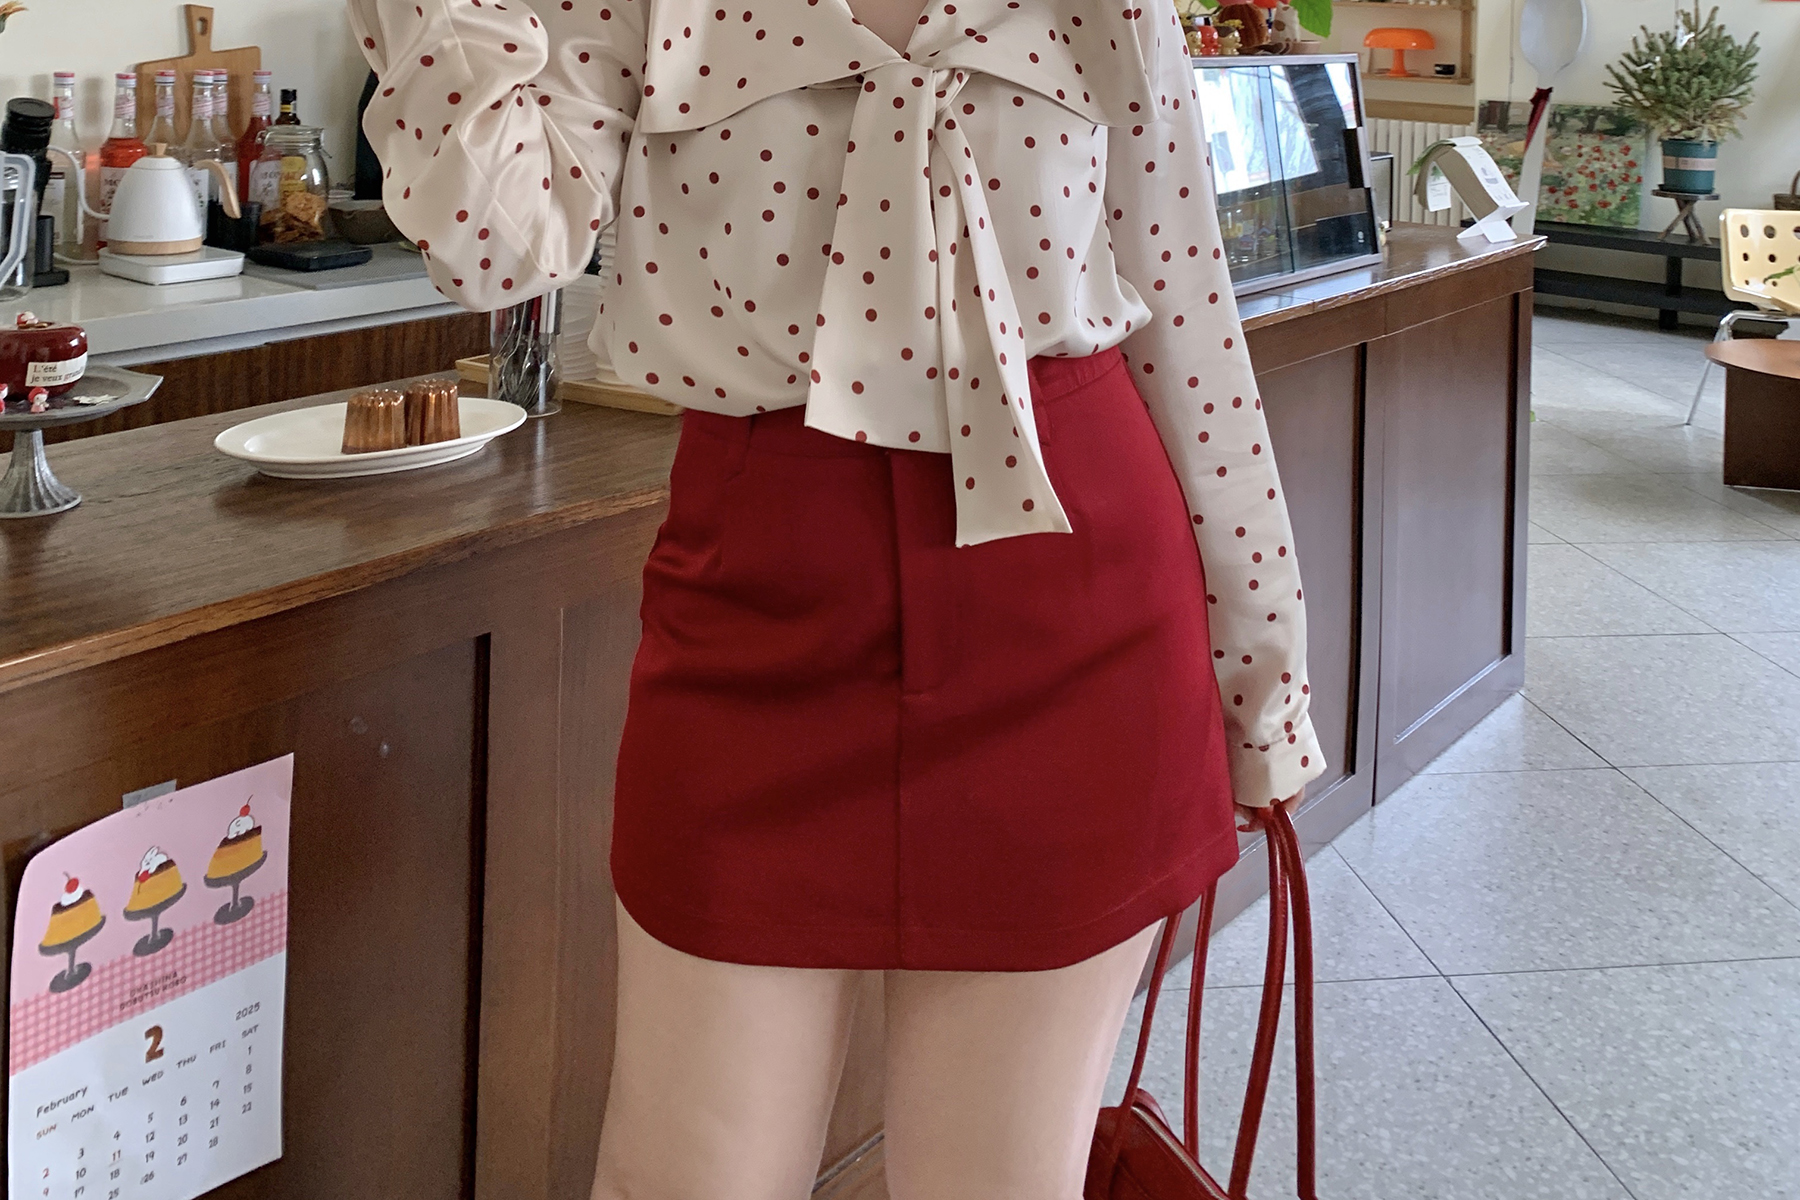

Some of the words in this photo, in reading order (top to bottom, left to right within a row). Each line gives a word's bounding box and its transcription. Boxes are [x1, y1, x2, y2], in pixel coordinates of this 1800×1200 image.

[30, 374, 40, 383] je
[33, 364, 58, 373] L'été
[235, 1001, 261, 1021] 2025
[144, 1024, 164, 1063] 2
[36, 1123, 58, 1140] SUN
[71, 1104, 95, 1122] MON
[107, 1086, 129, 1102] TUE
[142, 1070, 164, 1086] WED
[176, 1055, 197, 1069] THU
[209, 1039, 226, 1054] FRI
[241, 1024, 259, 1039] SAT
[36, 1085, 88, 1118] February
[42, 1167, 50, 1180] 2
[77, 1148, 85, 1160] 3
[113, 1130, 121, 1141] 4
[148, 1112, 153, 1123] 5
[180, 1096, 187, 1106] 6
[212, 1080, 220, 1089] 7
[245, 1064, 252, 1074] 8
[43, 1187, 50, 1197] 9
[76, 1167, 87, 1180] 10
[112, 1150, 121, 1162] 11
[145, 1130, 155, 1143] 12
[178, 1114, 188, 1126] 13
[210, 1099, 220, 1110] 14
[243, 1083, 253, 1094] 15
[74, 1185, 85, 1199] 17
[110, 1168, 120, 1181] 18
[145, 1150, 155, 1163] 19
[177, 1133, 188, 1147] 20
[209, 1116, 219, 1129] 21
[241, 1101, 252, 1114] 22
[108, 1187, 119, 1200] 25
[143, 1170, 155, 1184] 26
[177, 1153, 187, 1166] 27
[208, 1136, 219, 1149] 28
